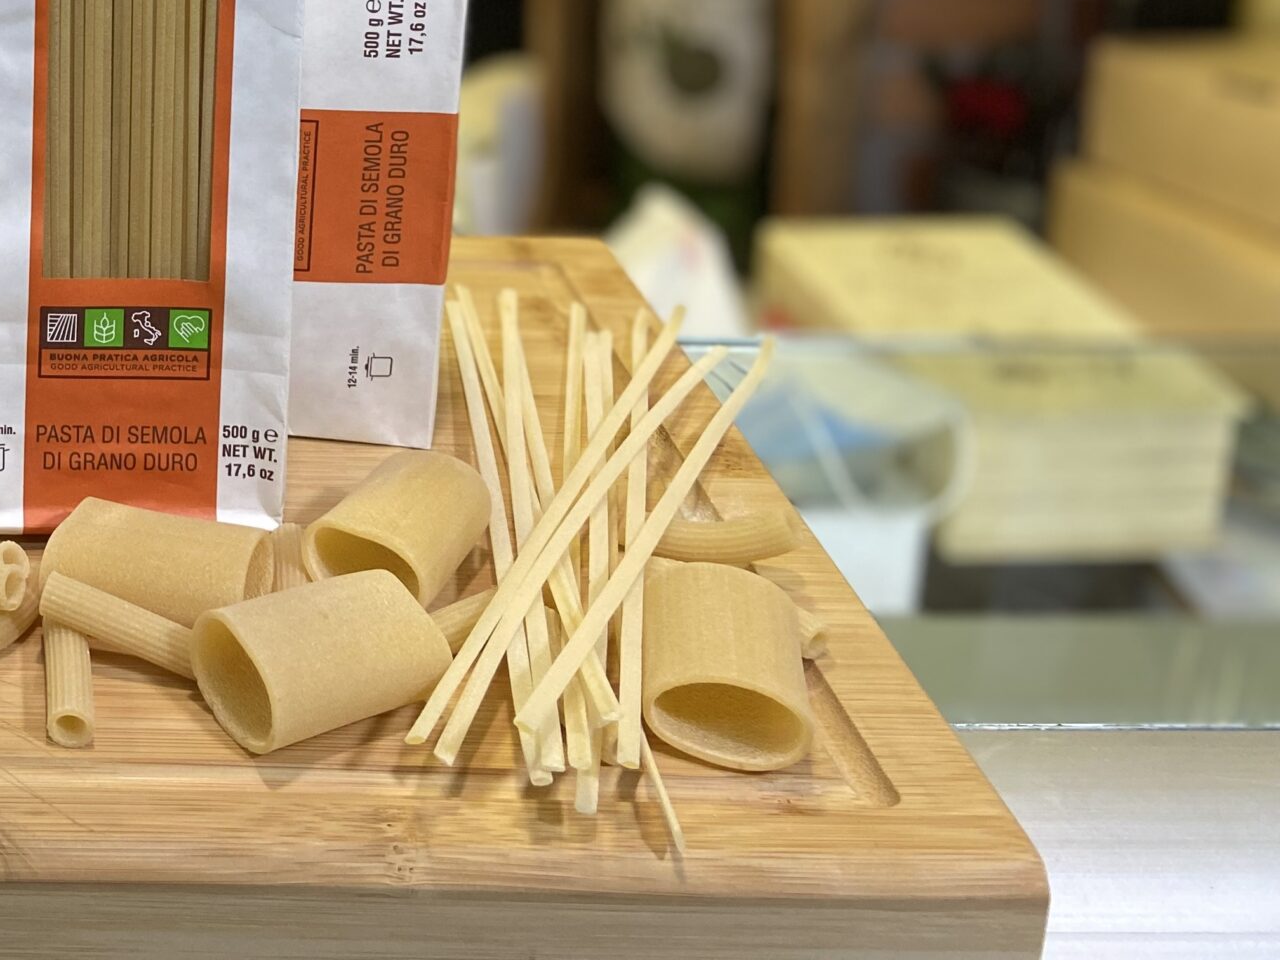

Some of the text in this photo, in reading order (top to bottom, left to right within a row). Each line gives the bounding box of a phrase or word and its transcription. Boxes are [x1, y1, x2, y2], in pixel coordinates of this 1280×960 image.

[368, 18, 384, 27] g
[408, 2, 426, 55] 17,6 oz
[363, 31, 380, 58] 500
[385, 30, 402, 58] NET
[296, 131, 311, 261] GOOD AGRICULTURAL PRACTICE
[355, 122, 384, 273] PASTA DI SEMOLA
[382, 130, 410, 267] DI GRANO DURO
[49, 353, 199, 363] BUONA PRATICA AGRICOLA
[50, 363, 197, 372] GOOD AGRICULTURAL PRACTICE
[347, 345, 360, 389] 12-14 min.
[35, 425, 207, 445] PASTA DI SEMOLA
[223, 425, 247, 439] 500
[251, 429, 260, 443] g
[43, 451, 198, 471] DI GRANO DURO
[222, 444, 277, 463] NET WT.
[225, 463, 274, 481] 17,6 oz
